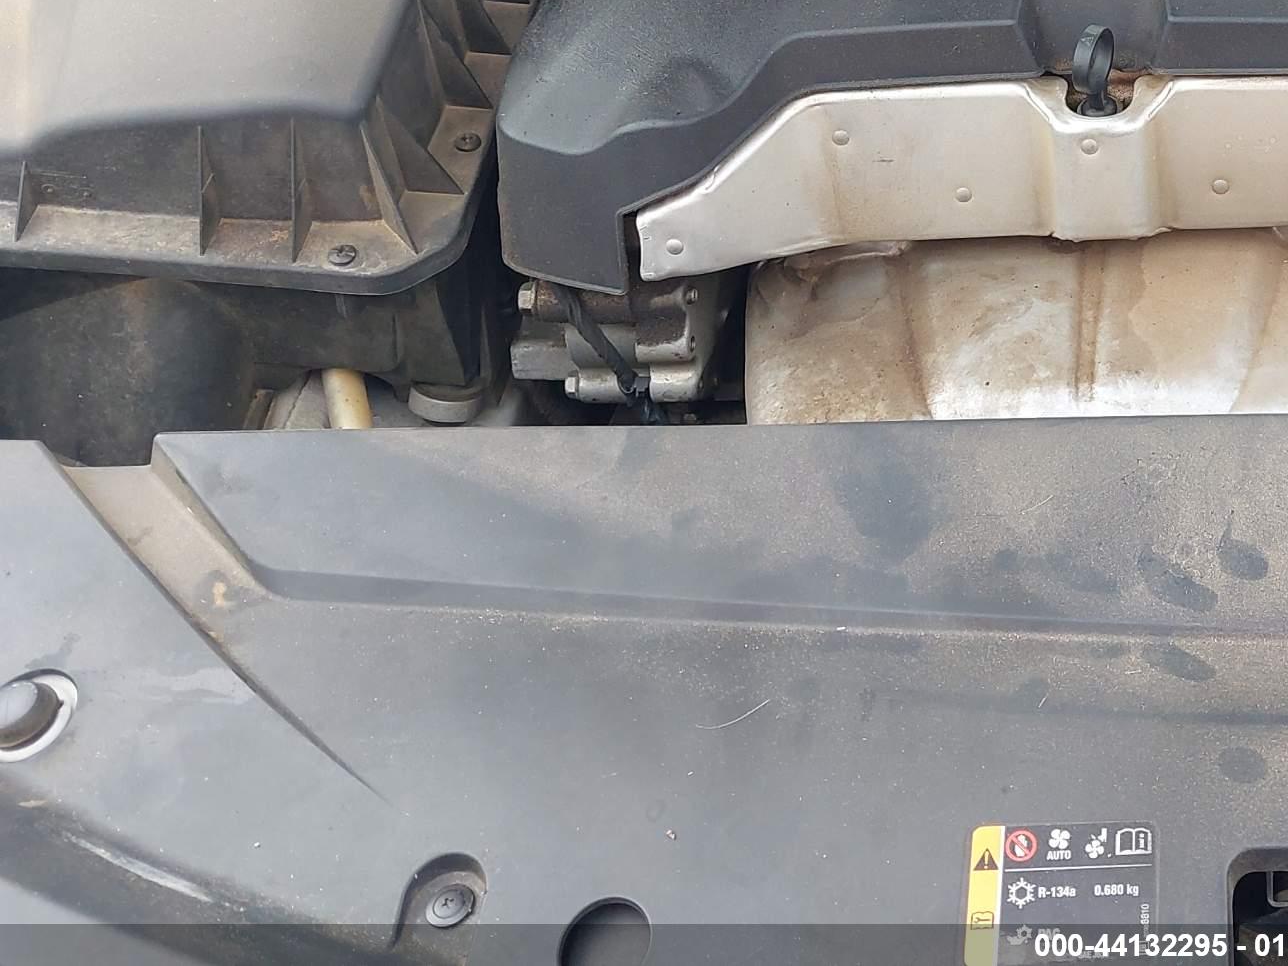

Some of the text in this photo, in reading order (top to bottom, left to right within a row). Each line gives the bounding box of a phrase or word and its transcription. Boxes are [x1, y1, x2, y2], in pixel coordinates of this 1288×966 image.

[1046, 850, 1072, 860] AUTO
[1038, 883, 1139, 898] R-134a 0.680 kg
